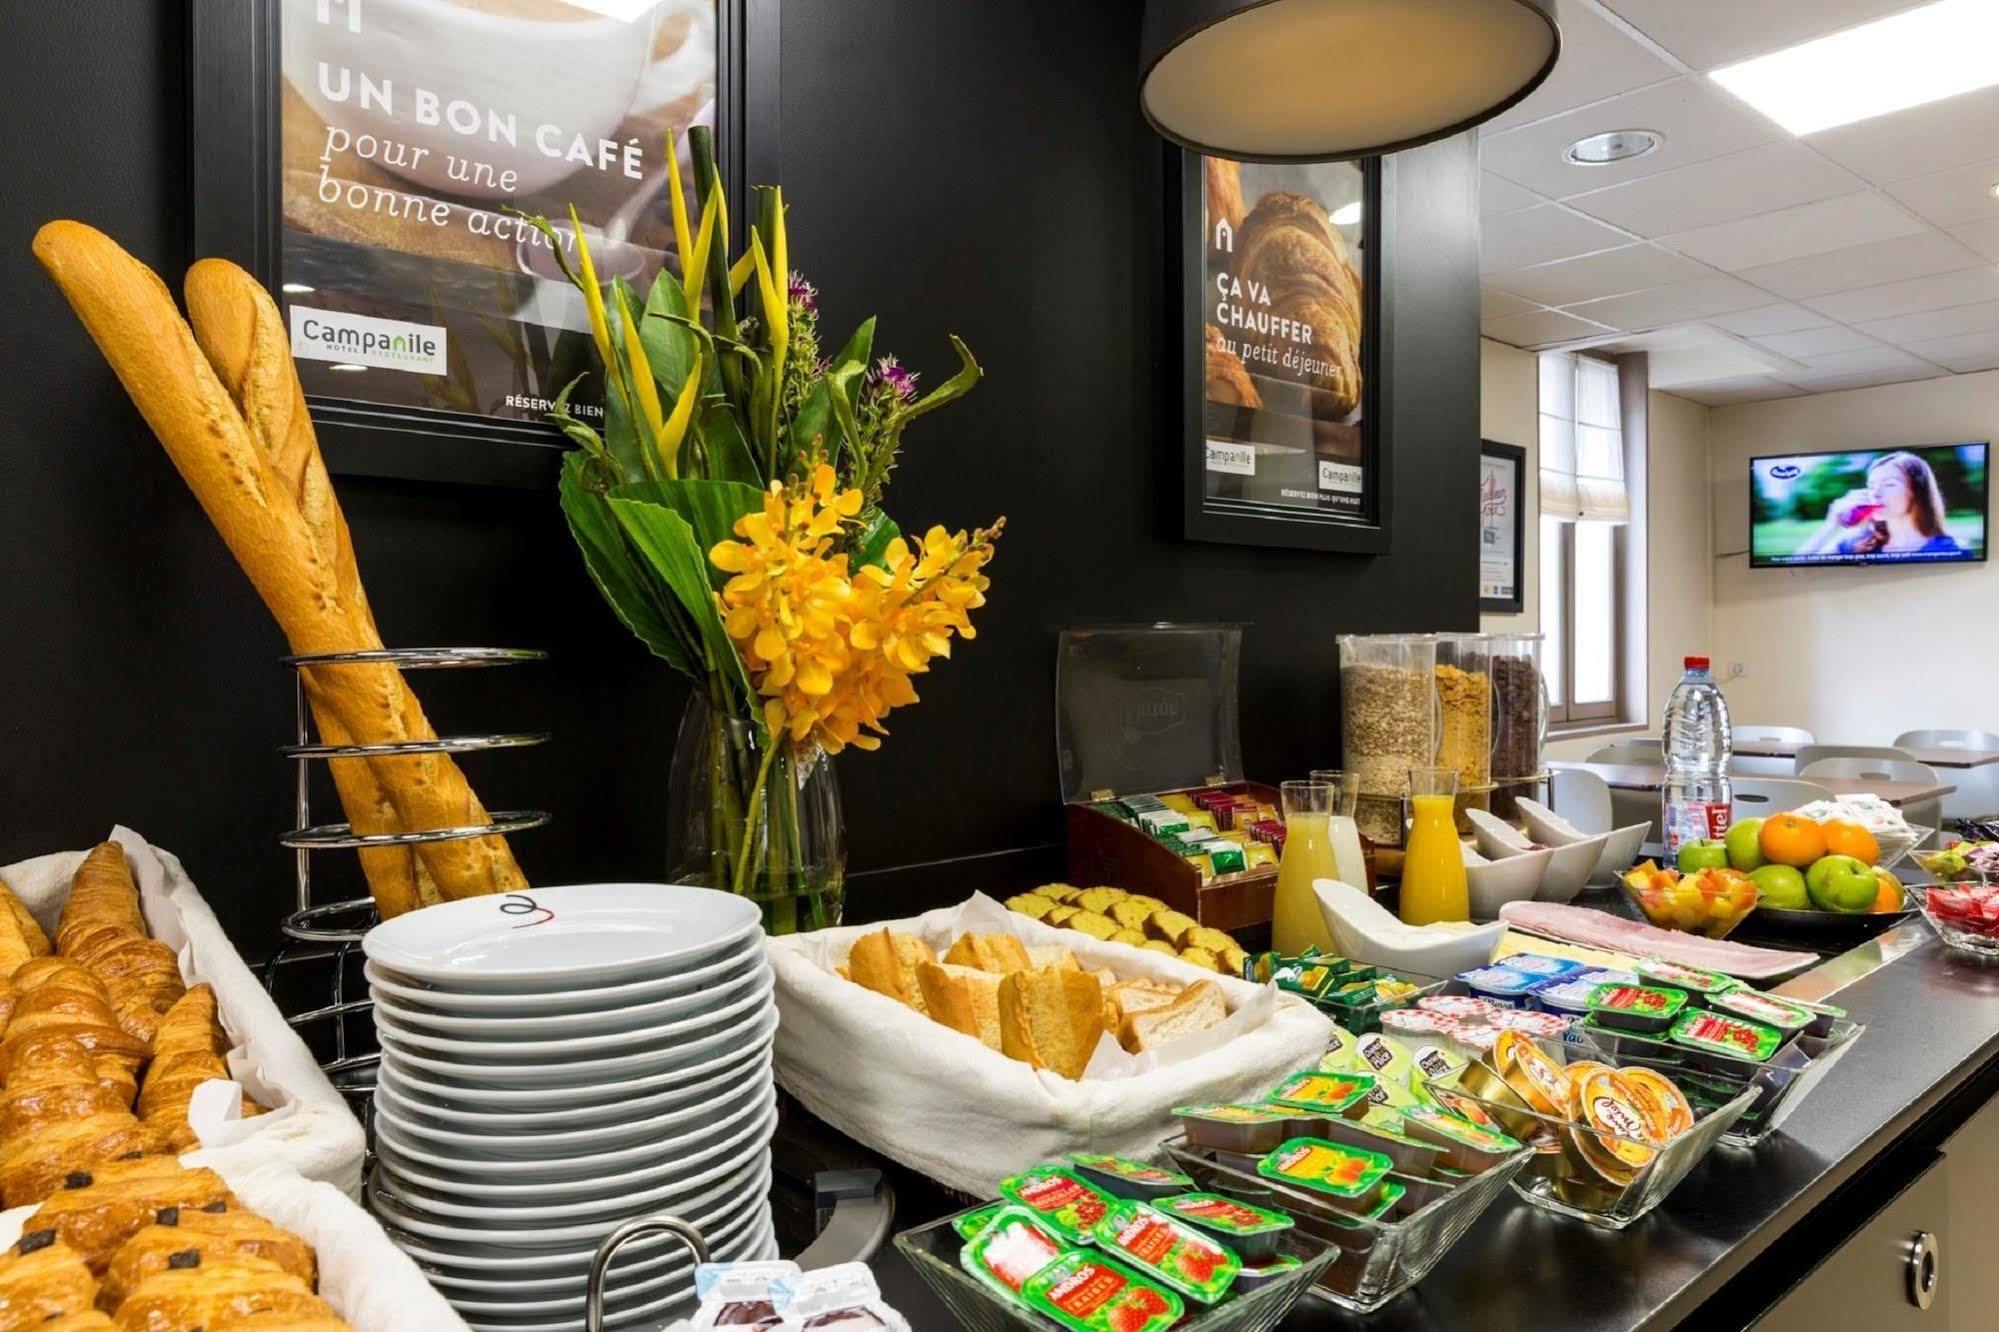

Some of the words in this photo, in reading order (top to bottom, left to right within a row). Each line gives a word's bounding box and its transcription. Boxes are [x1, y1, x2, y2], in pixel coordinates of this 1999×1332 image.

[319, 62, 392, 117] UN
[416, 88, 517, 148] BON
[536, 124, 643, 181] CAFÉ
[320, 126, 430, 171] pour
[447, 155, 519, 193] une
[319, 164, 451, 226] bonne
[1216, 272, 1243, 302] ÇA
[1247, 279, 1272, 307] VA
[303, 319, 436, 357] Campanile
[1216, 302, 1313, 345] CHAUFFER
[1216, 339, 1237, 355] au
[1241, 342, 1279, 365] petit
[1282, 347, 1343, 377] déjeuner
[505, 394, 572, 414] RÉSERVZ
[574, 403, 605, 418] BIEN
